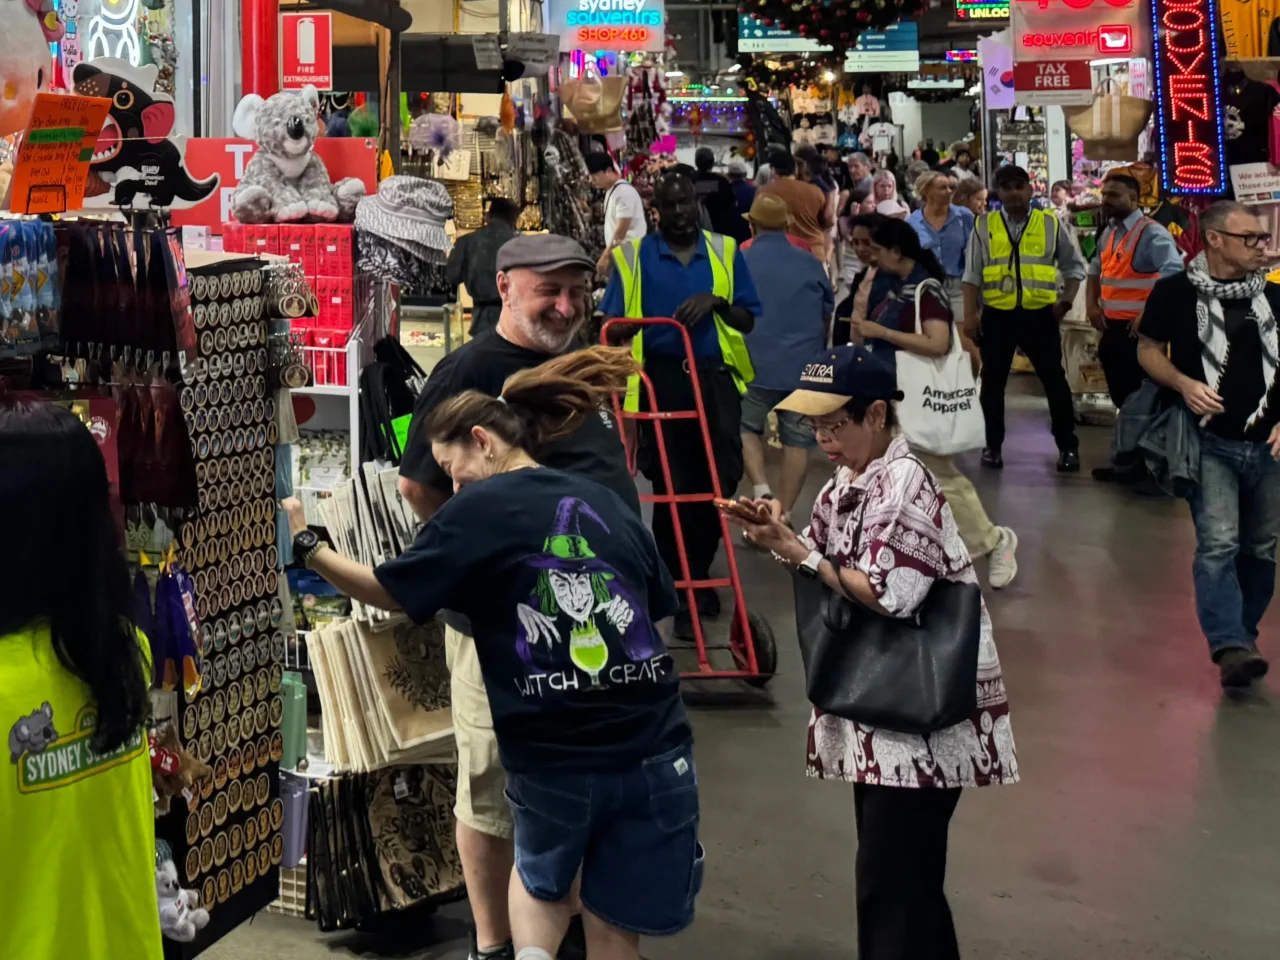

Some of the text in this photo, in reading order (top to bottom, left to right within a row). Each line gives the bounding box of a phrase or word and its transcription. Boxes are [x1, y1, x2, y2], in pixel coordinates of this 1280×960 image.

[567, 10, 662, 26] souvenirs
[578, 27, 649, 41] SHOP 460
[1023, 29, 1097, 46] souvenir
[297, 66, 315, 74] FIRE
[1037, 63, 1068, 75] TAX
[283, 75, 330, 83] EXTINGUISHER
[1034, 75, 1070, 88] FREE
[1238, 172, 1252, 180] We
[922, 384, 977, 401] Amercan
[922, 397, 972, 414] Appael
[514, 652, 670, 698] WITCH CRAF
[27, 741, 82, 783] SYDNEY
[390, 802, 450, 834] SYDNE
